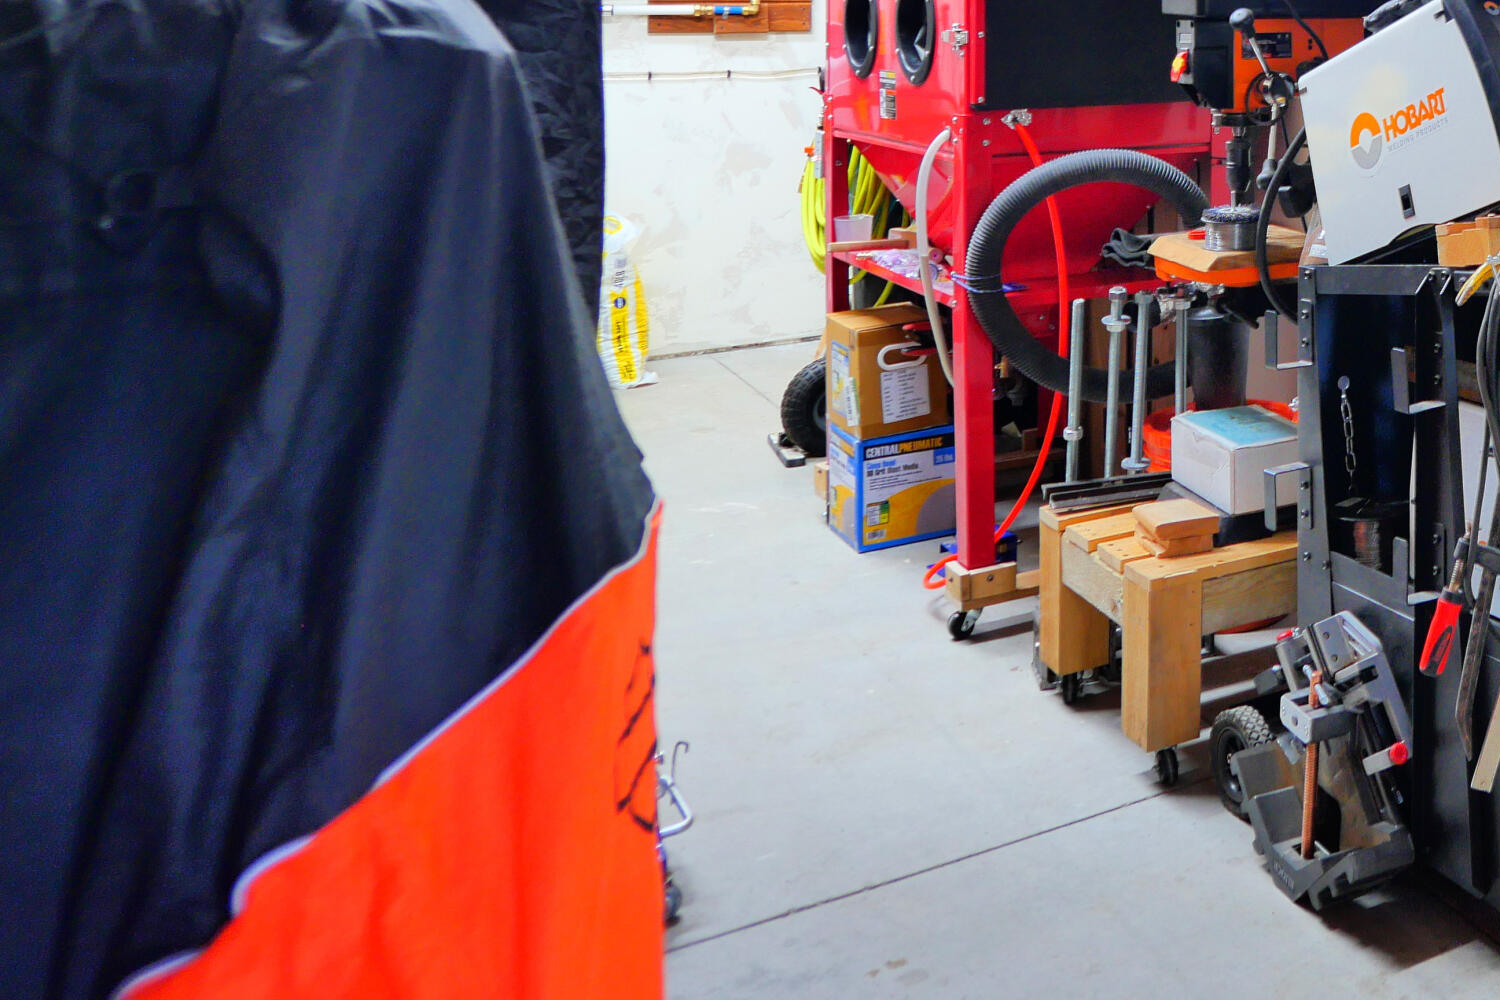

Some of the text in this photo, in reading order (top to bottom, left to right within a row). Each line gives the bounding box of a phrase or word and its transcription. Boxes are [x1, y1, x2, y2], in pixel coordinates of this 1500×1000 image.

[1383, 86, 1446, 143] HOBART
[1387, 116, 1449, 153] WELDING PRODUCTS
